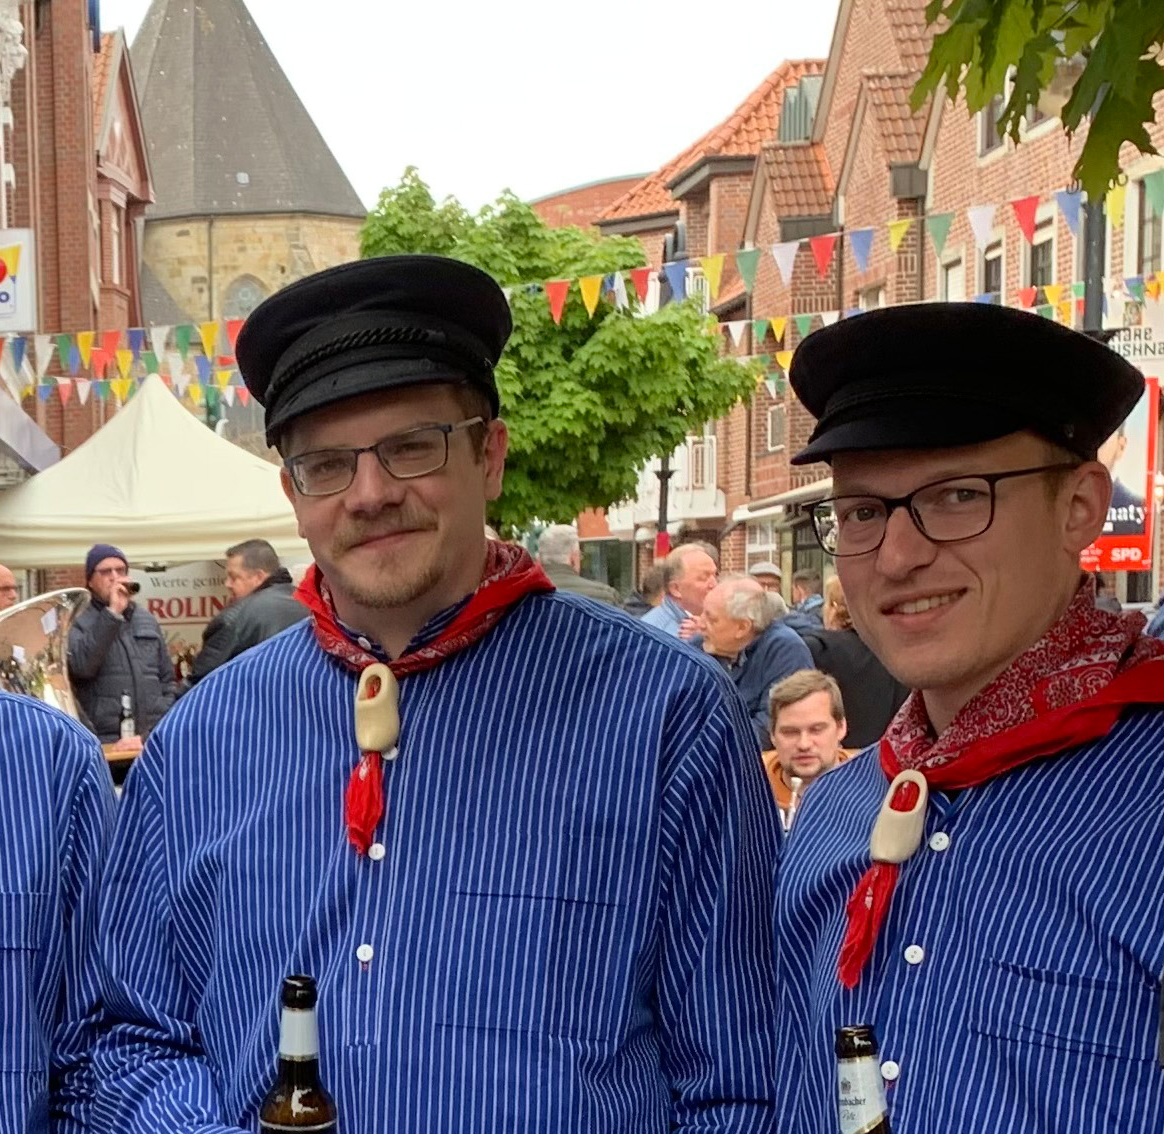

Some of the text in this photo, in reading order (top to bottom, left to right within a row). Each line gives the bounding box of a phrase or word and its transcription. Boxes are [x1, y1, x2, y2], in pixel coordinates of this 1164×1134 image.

[1111, 547, 1142, 562] SPD
[149, 576, 188, 588] Werte
[147, 596, 234, 618] ROLIN
